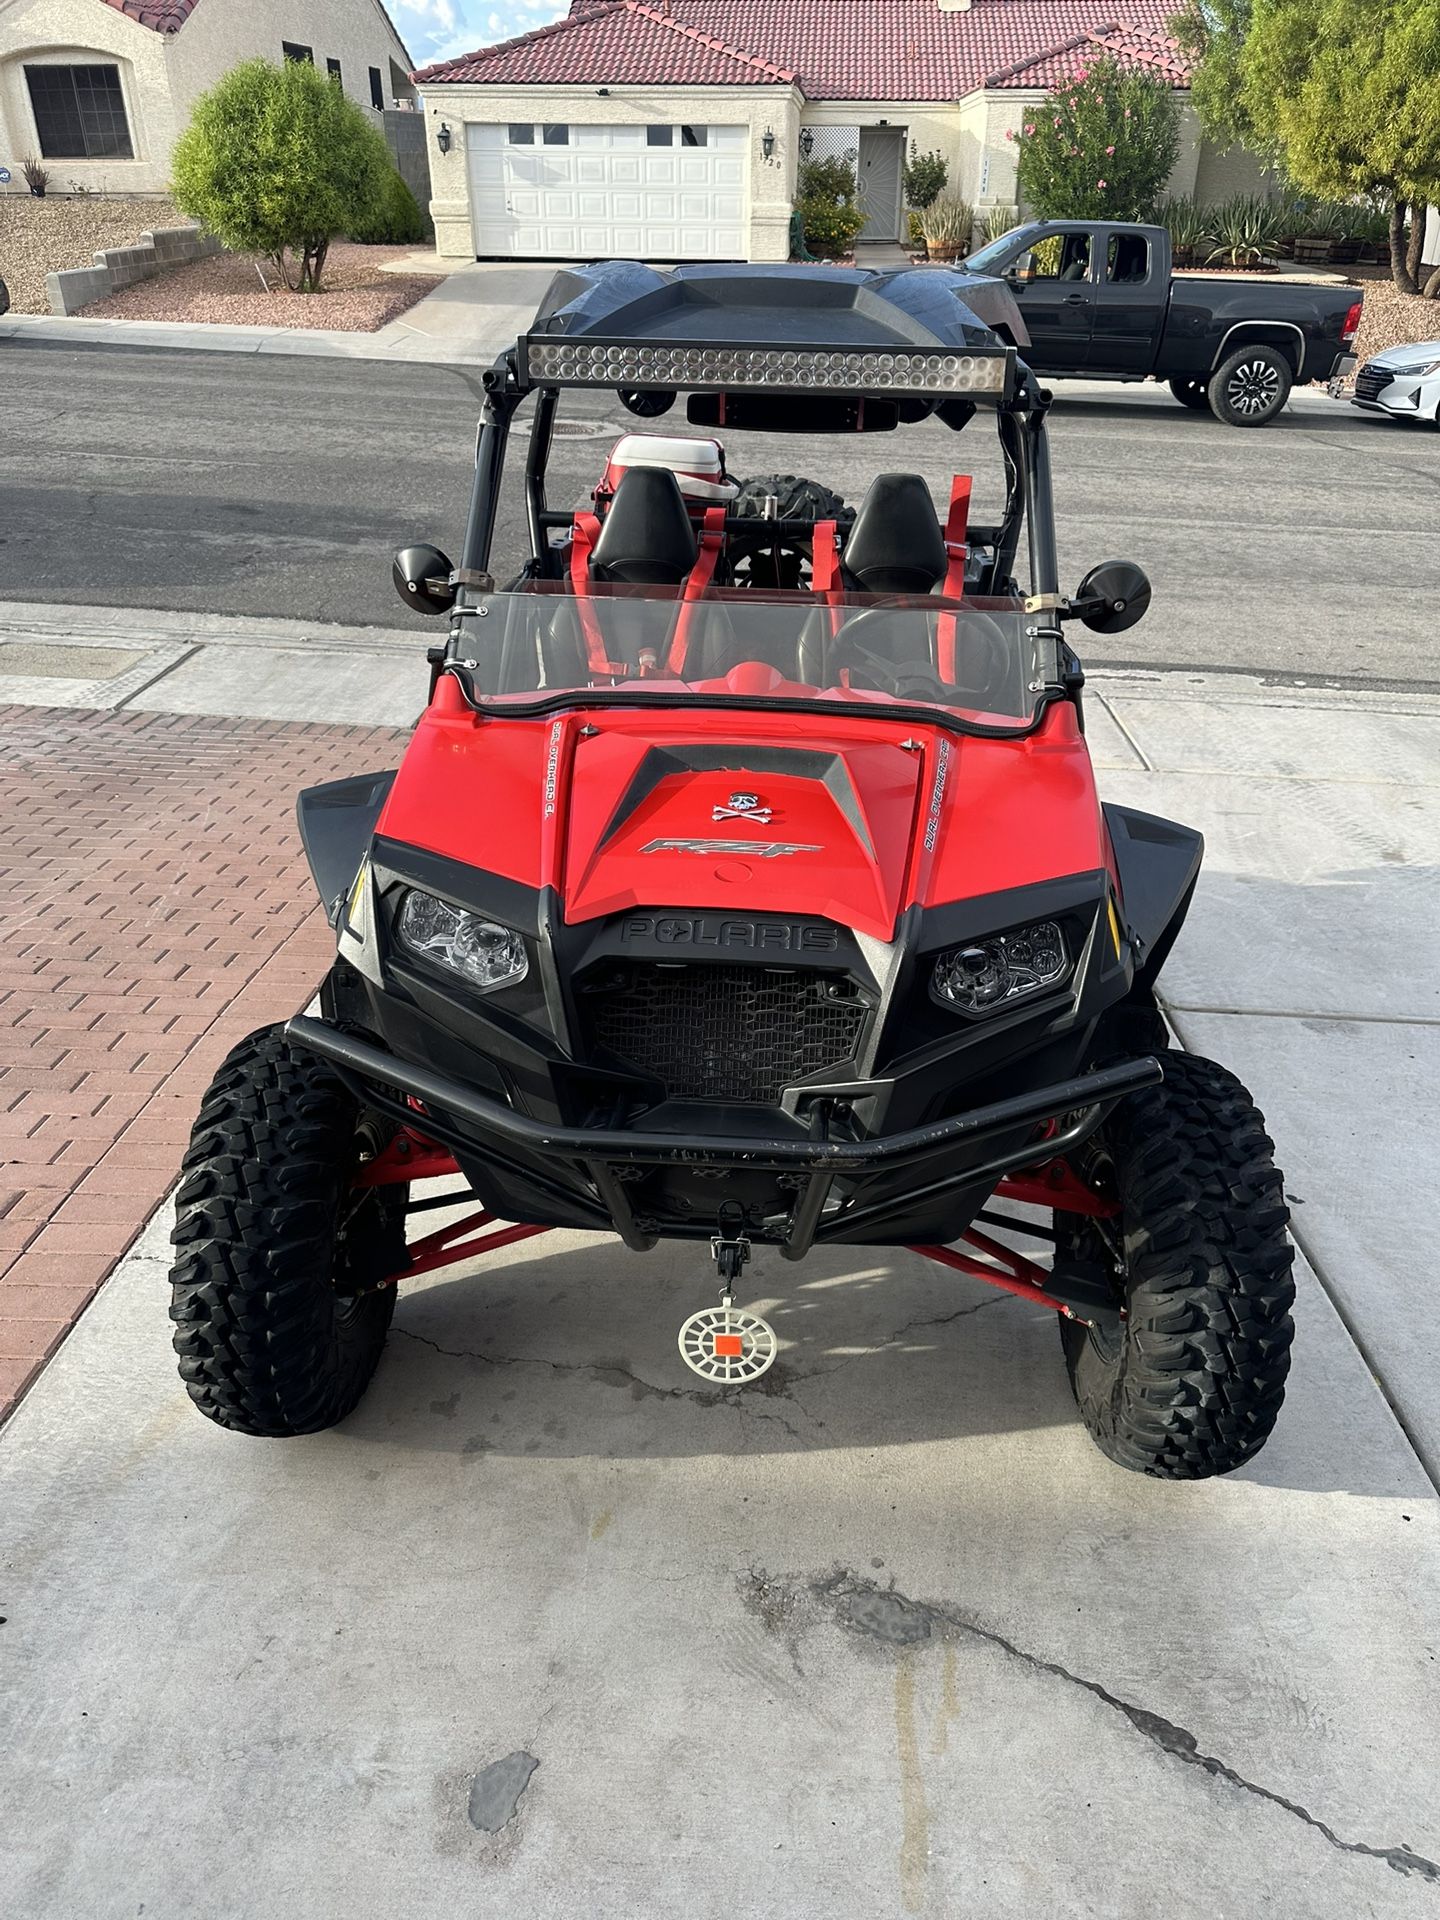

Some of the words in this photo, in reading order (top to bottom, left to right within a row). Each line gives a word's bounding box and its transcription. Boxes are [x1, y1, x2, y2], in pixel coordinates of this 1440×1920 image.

[545, 746, 559, 801] OVERHEAD
[924, 818, 938, 852] DUAL
[931, 758, 948, 816] OVERHEAD
[940, 738, 950, 760] CAM
[620, 917, 839, 952] POLARIS
